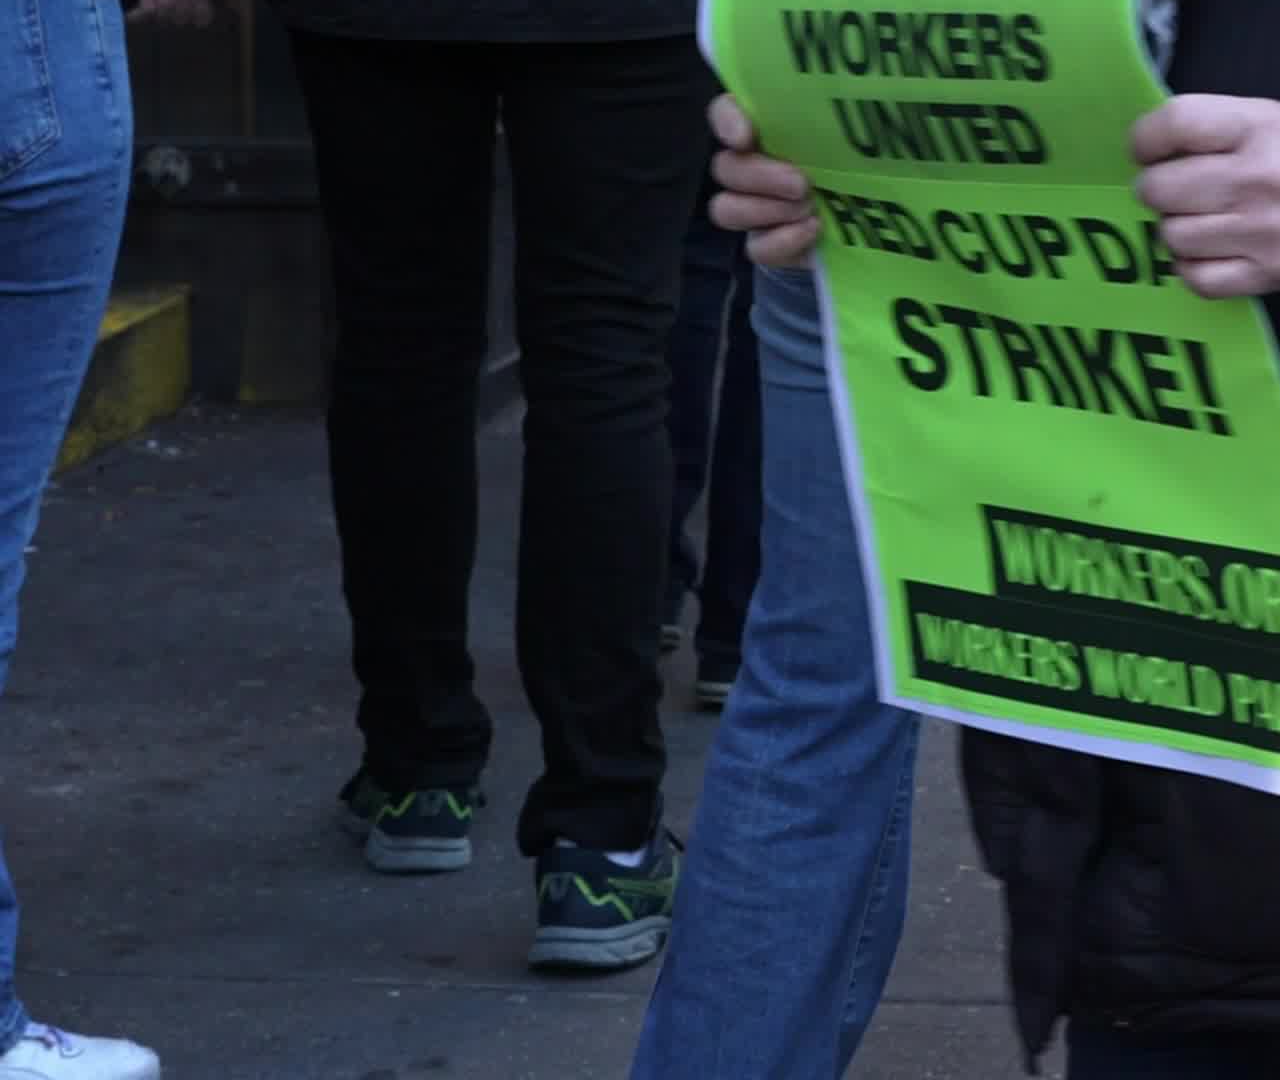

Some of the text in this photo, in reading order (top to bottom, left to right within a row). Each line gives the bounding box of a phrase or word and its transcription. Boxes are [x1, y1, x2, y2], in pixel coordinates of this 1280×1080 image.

[781, 9, 1050, 81] WORKERS
[831, 98, 1049, 164] UNITED
[813, 186, 937, 260] RED
[931, 209, 1072, 279] CUP
[889, 297, 1235, 436] STRIKE!
[915, 613, 1082, 691] WORKERS
[1082, 645, 1225, 715] WORLD
